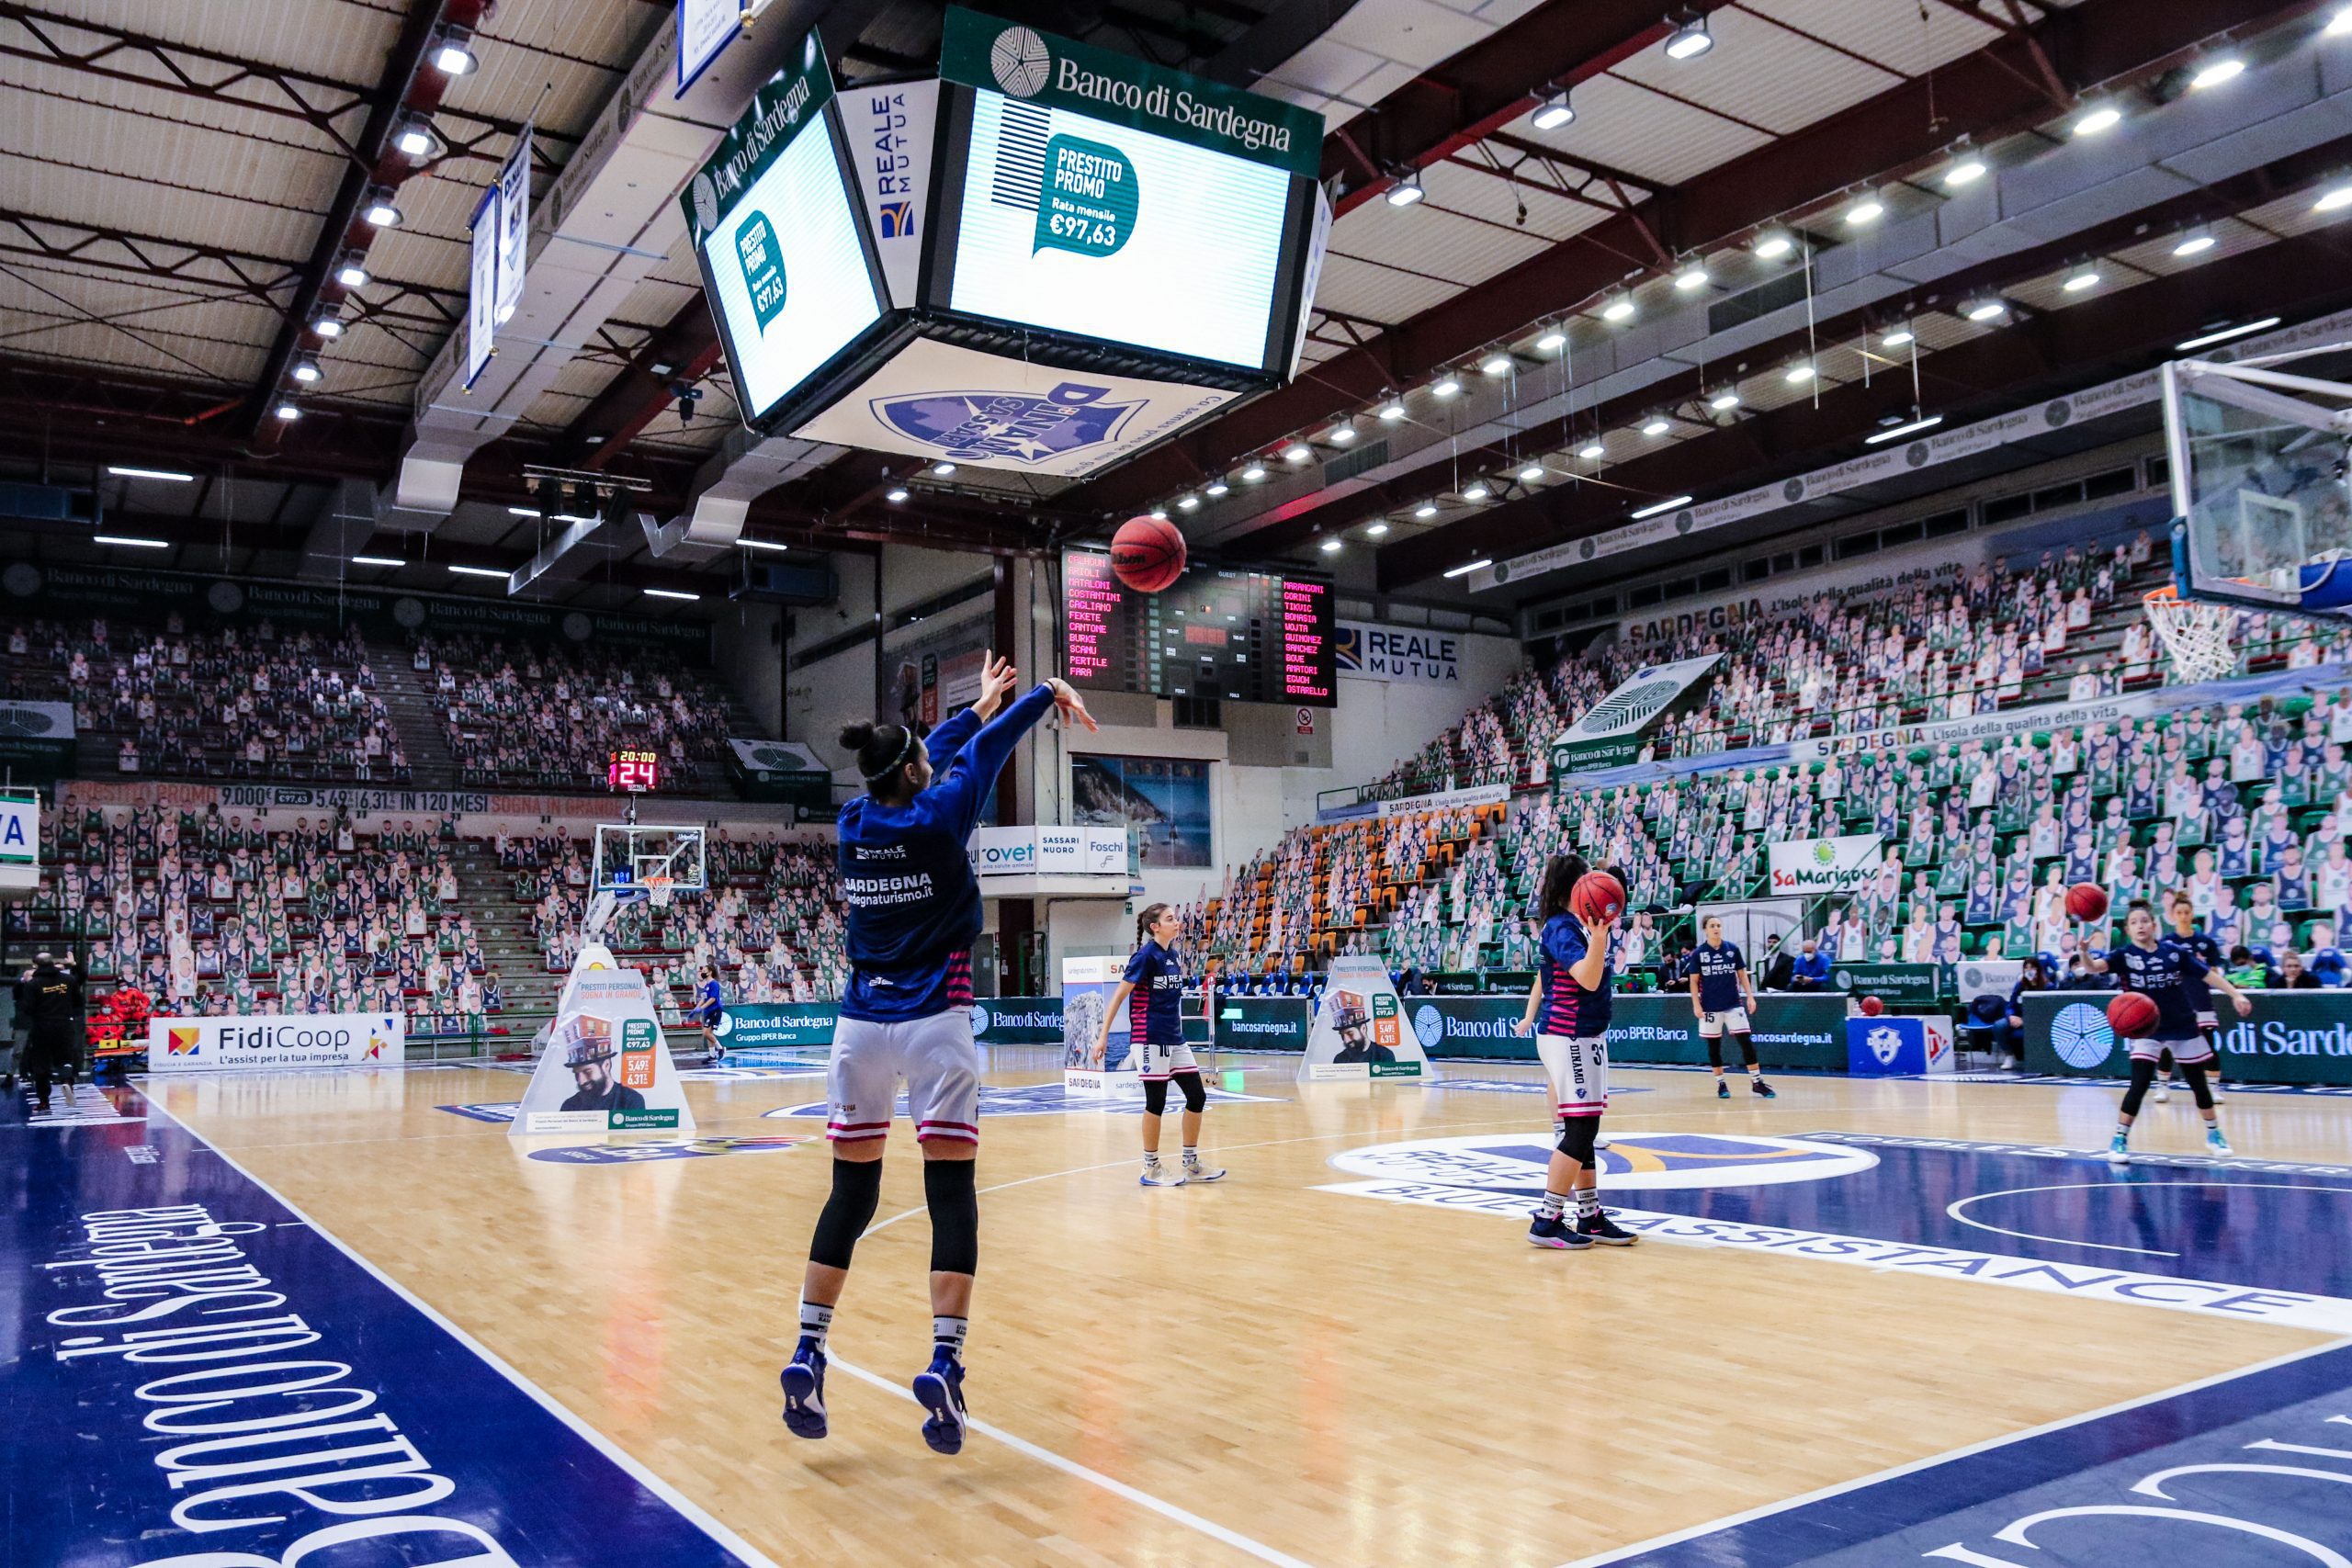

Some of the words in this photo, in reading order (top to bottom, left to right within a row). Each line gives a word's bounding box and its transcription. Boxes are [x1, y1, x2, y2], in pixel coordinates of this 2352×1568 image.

[1057, 57, 1142, 110] Banco
[1146, 85, 1170, 118] di
[1174, 91, 1291, 152] Sardegna
[714, 150, 748, 200] Banco
[746, 132, 758, 165] di
[754, 75, 810, 154] Sardegna
[898, 92, 911, 193] MUTUA
[872, 95, 892, 195] REALE
[1057, 147, 1123, 183] PRESTITO
[1055, 169, 1105, 199] PROMO
[1052, 197, 1076, 213] Rata
[1076, 204, 1116, 222] mensile
[1049, 213, 1117, 247] €97,63
[740, 220, 767, 258] PRESTITO
[744, 243, 767, 276] PROMO
[756, 276, 784, 313] €97,63
[930, 396, 1022, 447] SASSARI
[1069, 555, 1105, 568] CALHOUN
[1069, 567, 1100, 578] ARIOLI
[1218, 570, 1236, 579] GUEST
[1069, 578, 1111, 591] MATALONI
[1283, 581, 1324, 594] MARANGONI
[1069, 589, 1121, 603] COSTANTINI
[1283, 592, 1312, 603] GORINI
[1630, 599, 1764, 643] SARDEGNA
[1935, 561, 1962, 577] vita
[1069, 600, 1112, 613] GAGLIANO
[1284, 602, 1313, 613] TIKVIC
[1069, 611, 1102, 622] FEKETE
[1284, 613, 1317, 624] BONASIA
[1069, 622, 1107, 634] CANTONE
[1284, 623, 1308, 633] WOJTA
[1069, 633, 1097, 644] BURKE
[1069, 644, 1097, 655] SCANU
[1285, 644, 1317, 654] SANCHEZ
[1369, 631, 1457, 662] REALE
[1069, 656, 1108, 667] PERTILE
[1285, 654, 1305, 663] BOVE
[1069, 667, 1092, 677] FARA
[1286, 664, 1317, 675] AMATORI
[1370, 658, 1458, 681] MUTUA
[1286, 685, 1329, 696] OSTARELLO
[1818, 728, 1926, 756] SARDEGNA
[1933, 726, 1968, 740] L'Isola
[1973, 721, 2002, 736] della
[2006, 716, 2052, 736] qualità
[2055, 709, 2087, 725] della
[2091, 705, 2119, 718] vita
[620, 751, 657, 763] 20:00
[1571, 750, 1594, 762] Banco
[620, 762, 655, 784] 24
[222, 785, 273, 807] 9.000€
[277, 794, 309, 805] €97,63
[401, 792, 416, 811] IN
[422, 793, 447, 812] 120
[452, 794, 489, 813] MESI
[1389, 797, 1433, 813] SARDEGNA
[1091, 841, 1124, 853] Foschi
[844, 873, 933, 893] SARDEGNA
[1700, 953, 1710, 964] 15
[581, 983, 607, 991] PRESTITI
[1852, 974, 1880, 986] Banco
[1881, 974, 1888, 985] di
[1888, 975, 1930, 987] Sardegna
[736, 1017, 770, 1030] Banco
[771, 1016, 781, 1028] di
[782, 1015, 833, 1030] Sardegna
[993, 1011, 1024, 1027] Banco
[1024, 1010, 1034, 1026] di
[1034, 1011, 1064, 1031] Sardeg
[1704, 1011, 1714, 1023] 15
[1232, 1021, 1297, 1034] bancosardegna.it
[1446, 1017, 1488, 1038] Banco
[1491, 1017, 1506, 1038] di
[1630, 1026, 1656, 1040] BPER
[1657, 1027, 1689, 1041] Banca
[220, 1026, 350, 1051] FidiCoop
[736, 1033, 761, 1043] Gruppo
[761, 1032, 777, 1041] BPER
[1751, 1032, 1833, 1045] ancosardegna.it
[2227, 1021, 2256, 1055] di
[2262, 1021, 2352, 1056] Sard
[220, 1054, 258, 1065] L'assist
[261, 1055, 277, 1065] per
[279, 1054, 288, 1063] la
[290, 1054, 307, 1062] tua
[310, 1053, 349, 1063] impresa
[1569, 1044, 1585, 1085] DINAMO
[1069, 1077, 1101, 1089] SARDEGNA
[649, 1113, 675, 1122] Sardegna
[1346, 1153, 1496, 1185] MUTUA
[1389, 1150, 1549, 1181] REALE
[1369, 1185, 1538, 1211] BLUE
[1610, 1214, 2316, 1316] ASSISTANCE
[45, 1203, 288, 1326] Sardegna
[55, 1313, 322, 1362] di
